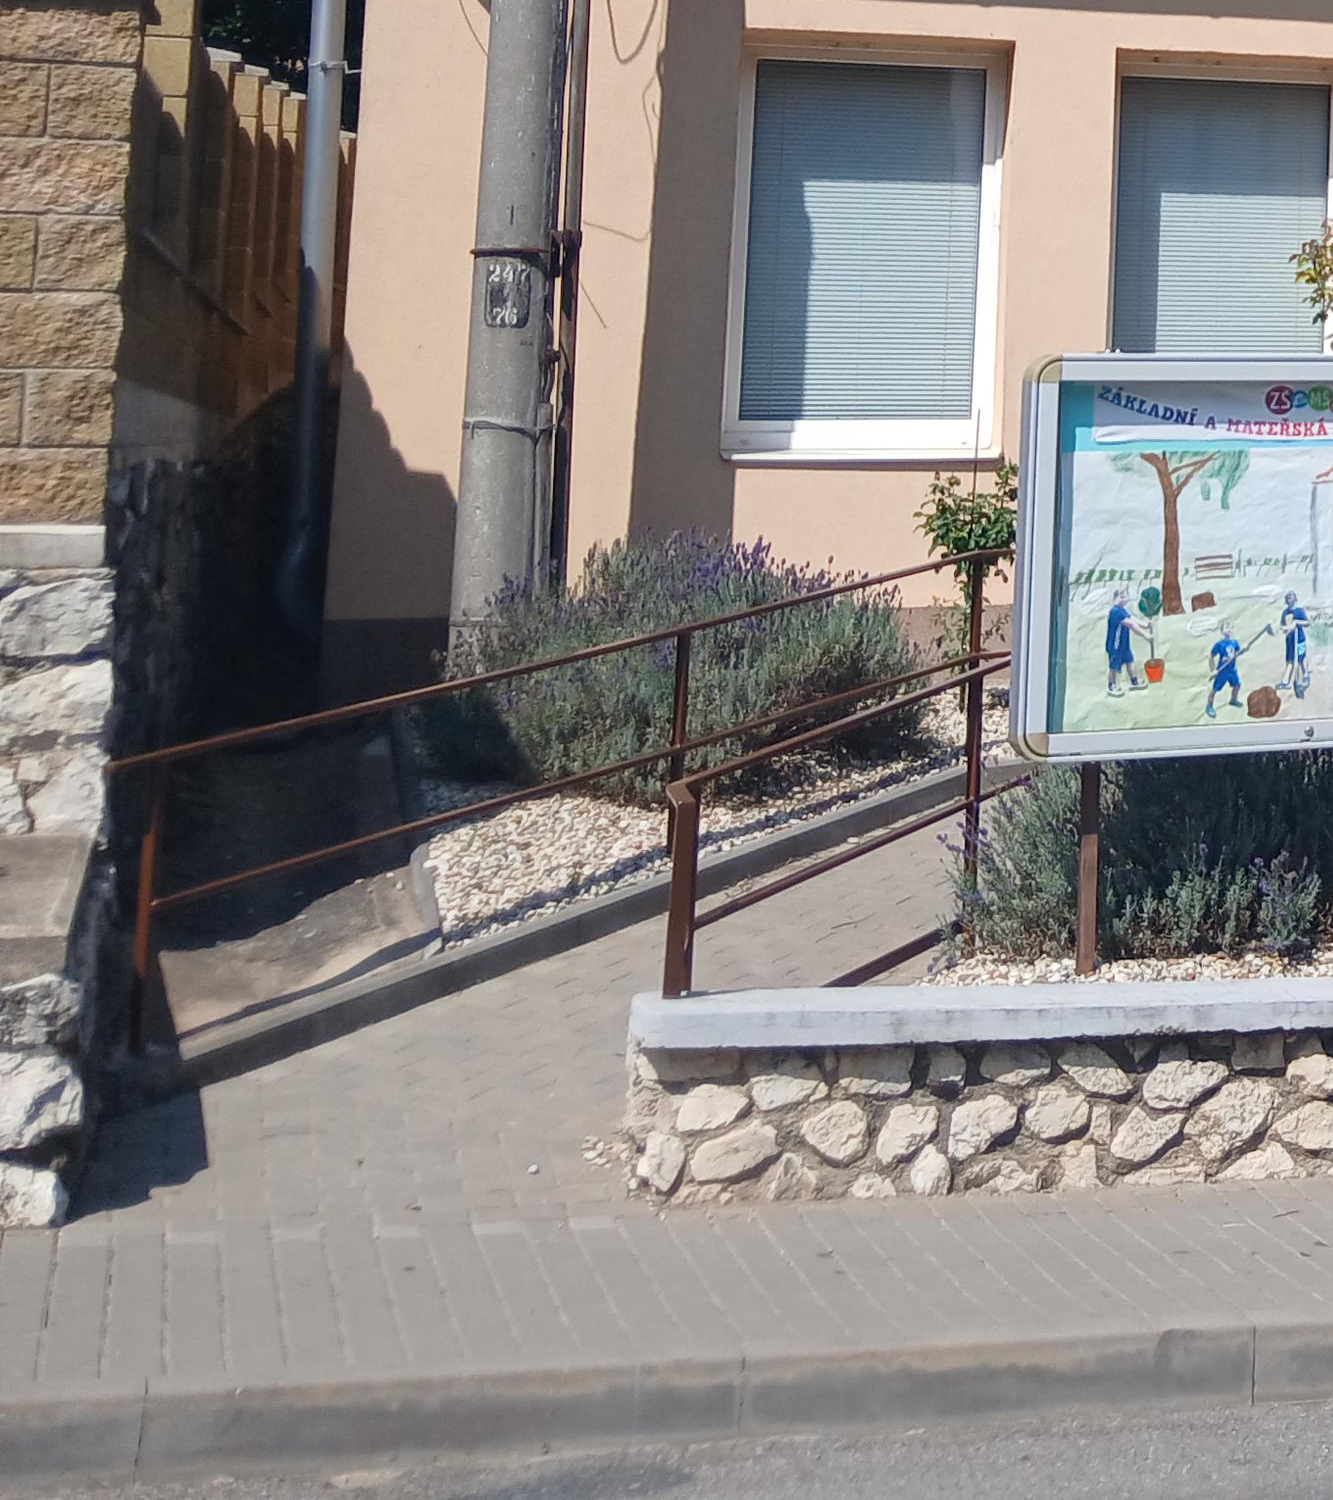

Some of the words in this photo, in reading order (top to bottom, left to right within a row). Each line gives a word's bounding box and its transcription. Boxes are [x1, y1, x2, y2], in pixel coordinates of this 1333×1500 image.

[1097, 385, 1198, 426] ZÁKLADNÍ
[1204, 415, 1216, 430] A
[1226, 417, 1328, 437] MATEŘSKÁ
